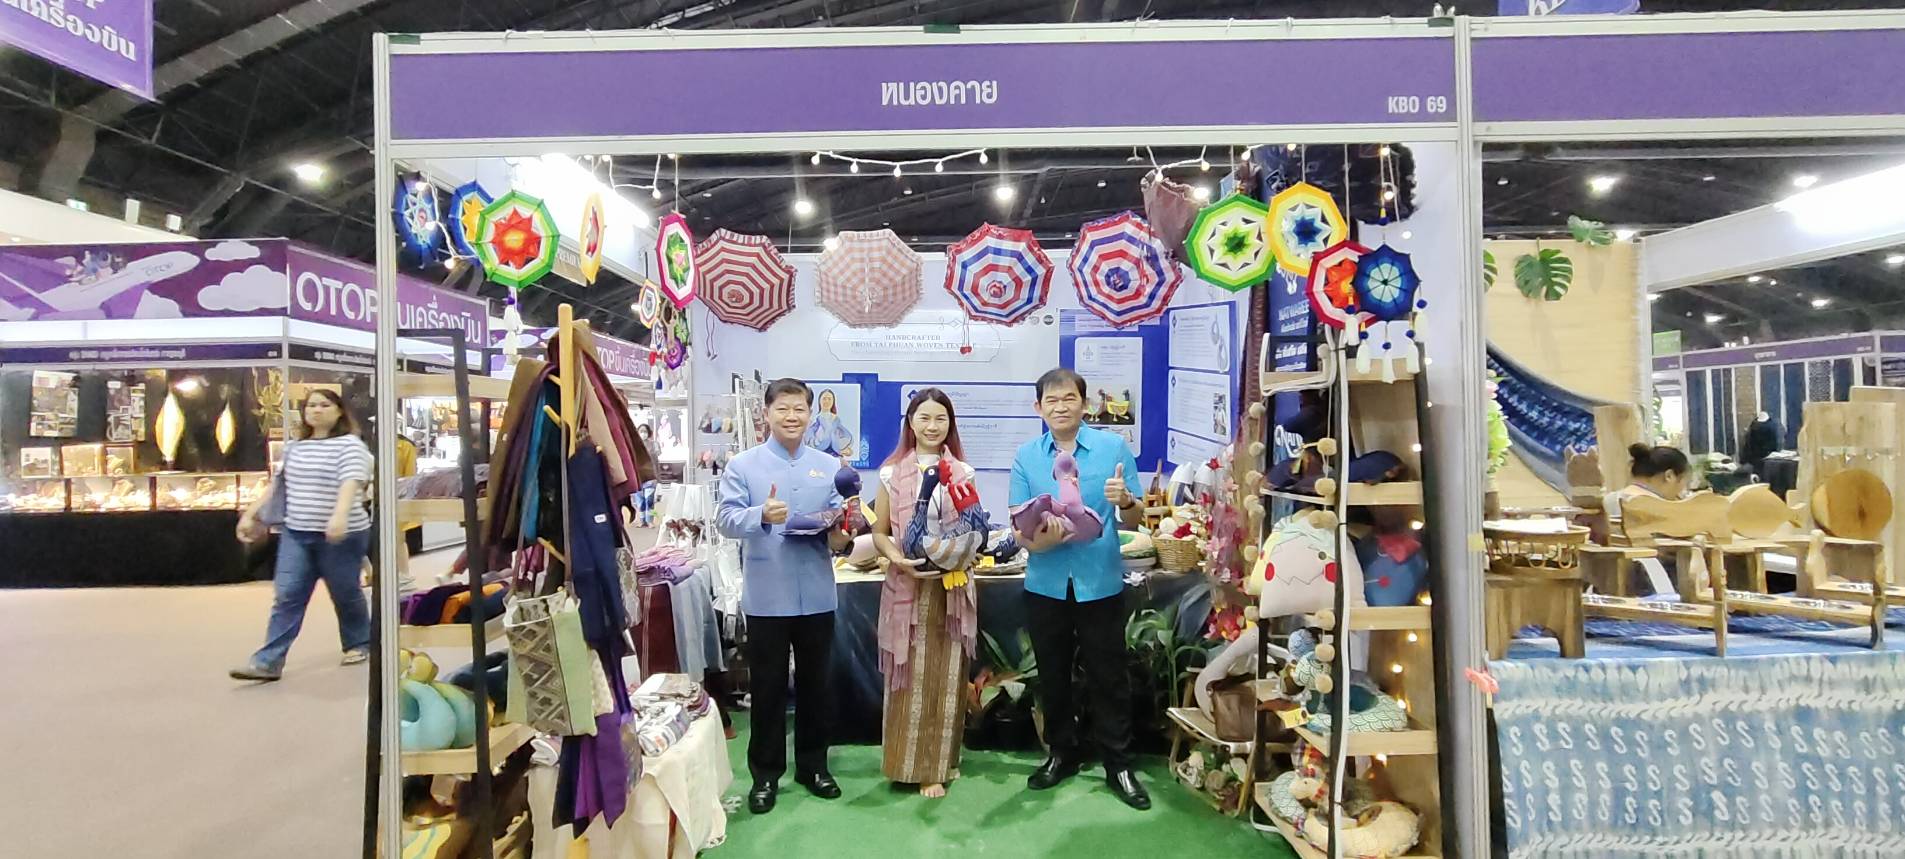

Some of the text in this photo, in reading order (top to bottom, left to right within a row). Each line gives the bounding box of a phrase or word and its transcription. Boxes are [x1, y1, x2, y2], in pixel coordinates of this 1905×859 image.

[881, 80, 998, 106] หนองคาย
[1388, 95, 1447, 114] KBO 69
